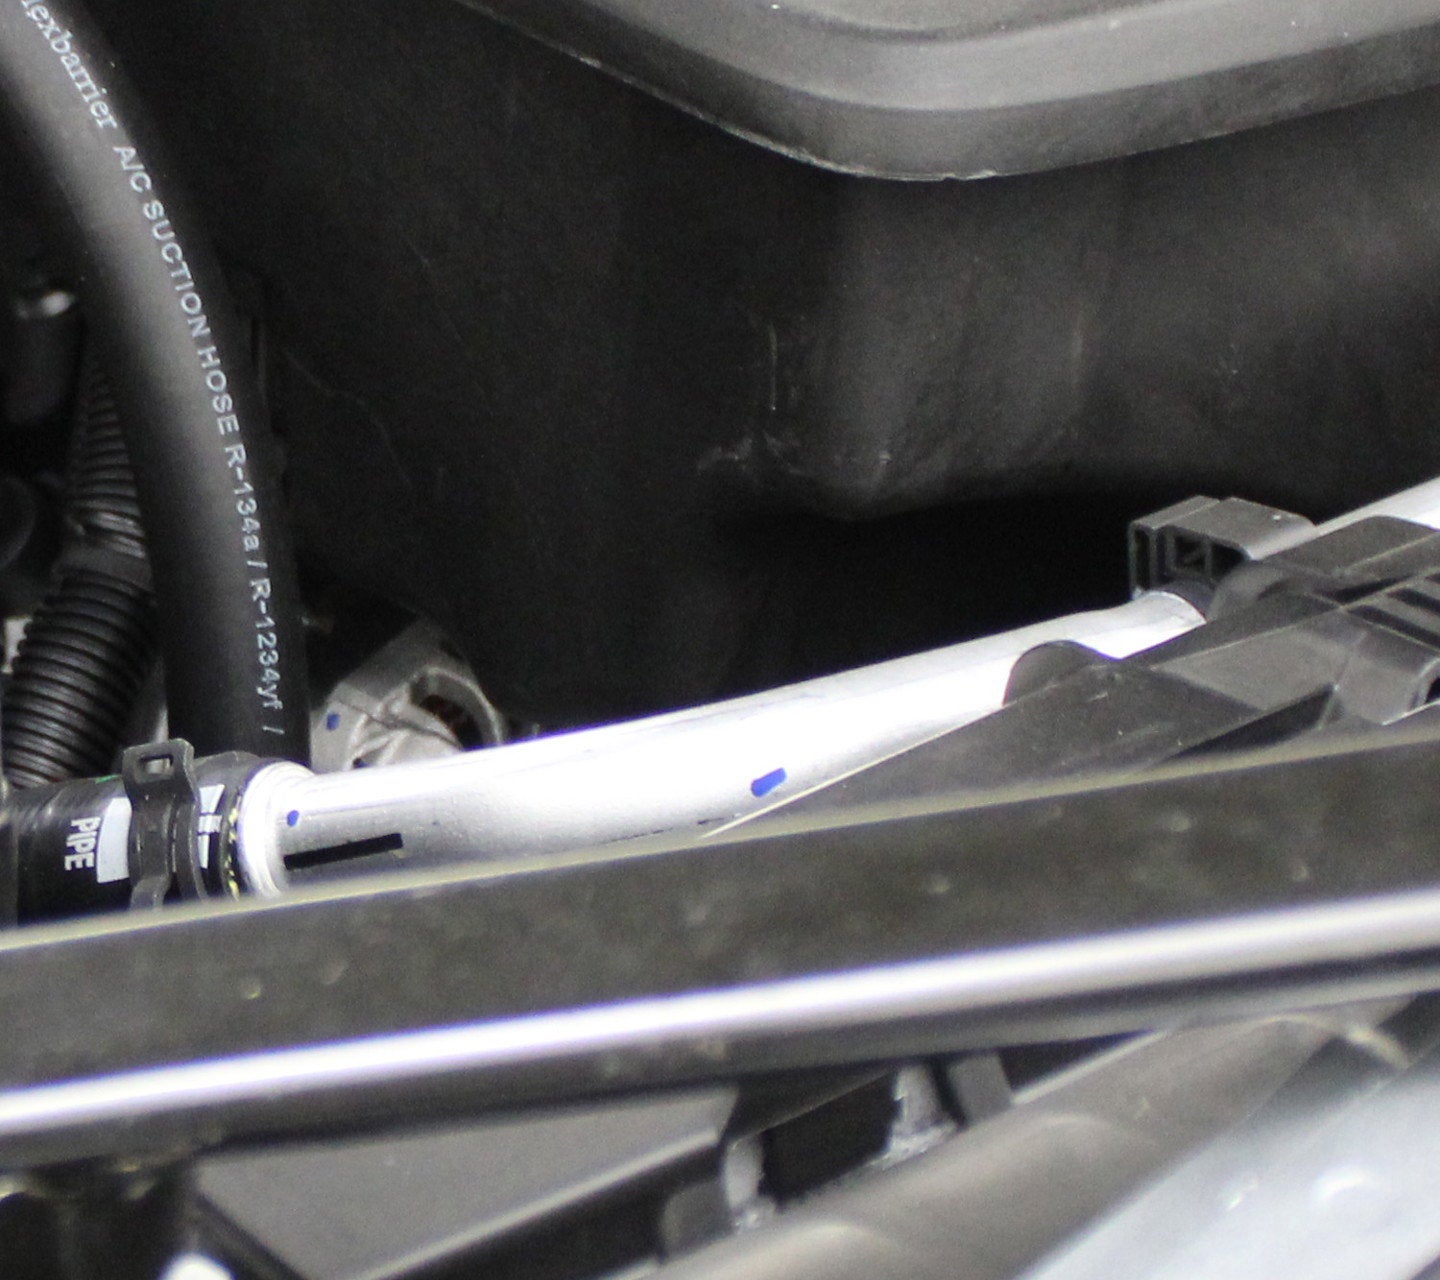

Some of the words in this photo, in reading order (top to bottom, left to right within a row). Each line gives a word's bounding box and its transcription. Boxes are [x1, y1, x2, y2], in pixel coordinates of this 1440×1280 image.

[112, 146, 152, 193] A/C
[143, 199, 211, 337] SUCTION
[197, 346, 240, 435] HOSE
[224, 442, 261, 552] R-134a
[248, 576, 284, 711] R-1234yf
[64, 816, 102, 871] PIPE
